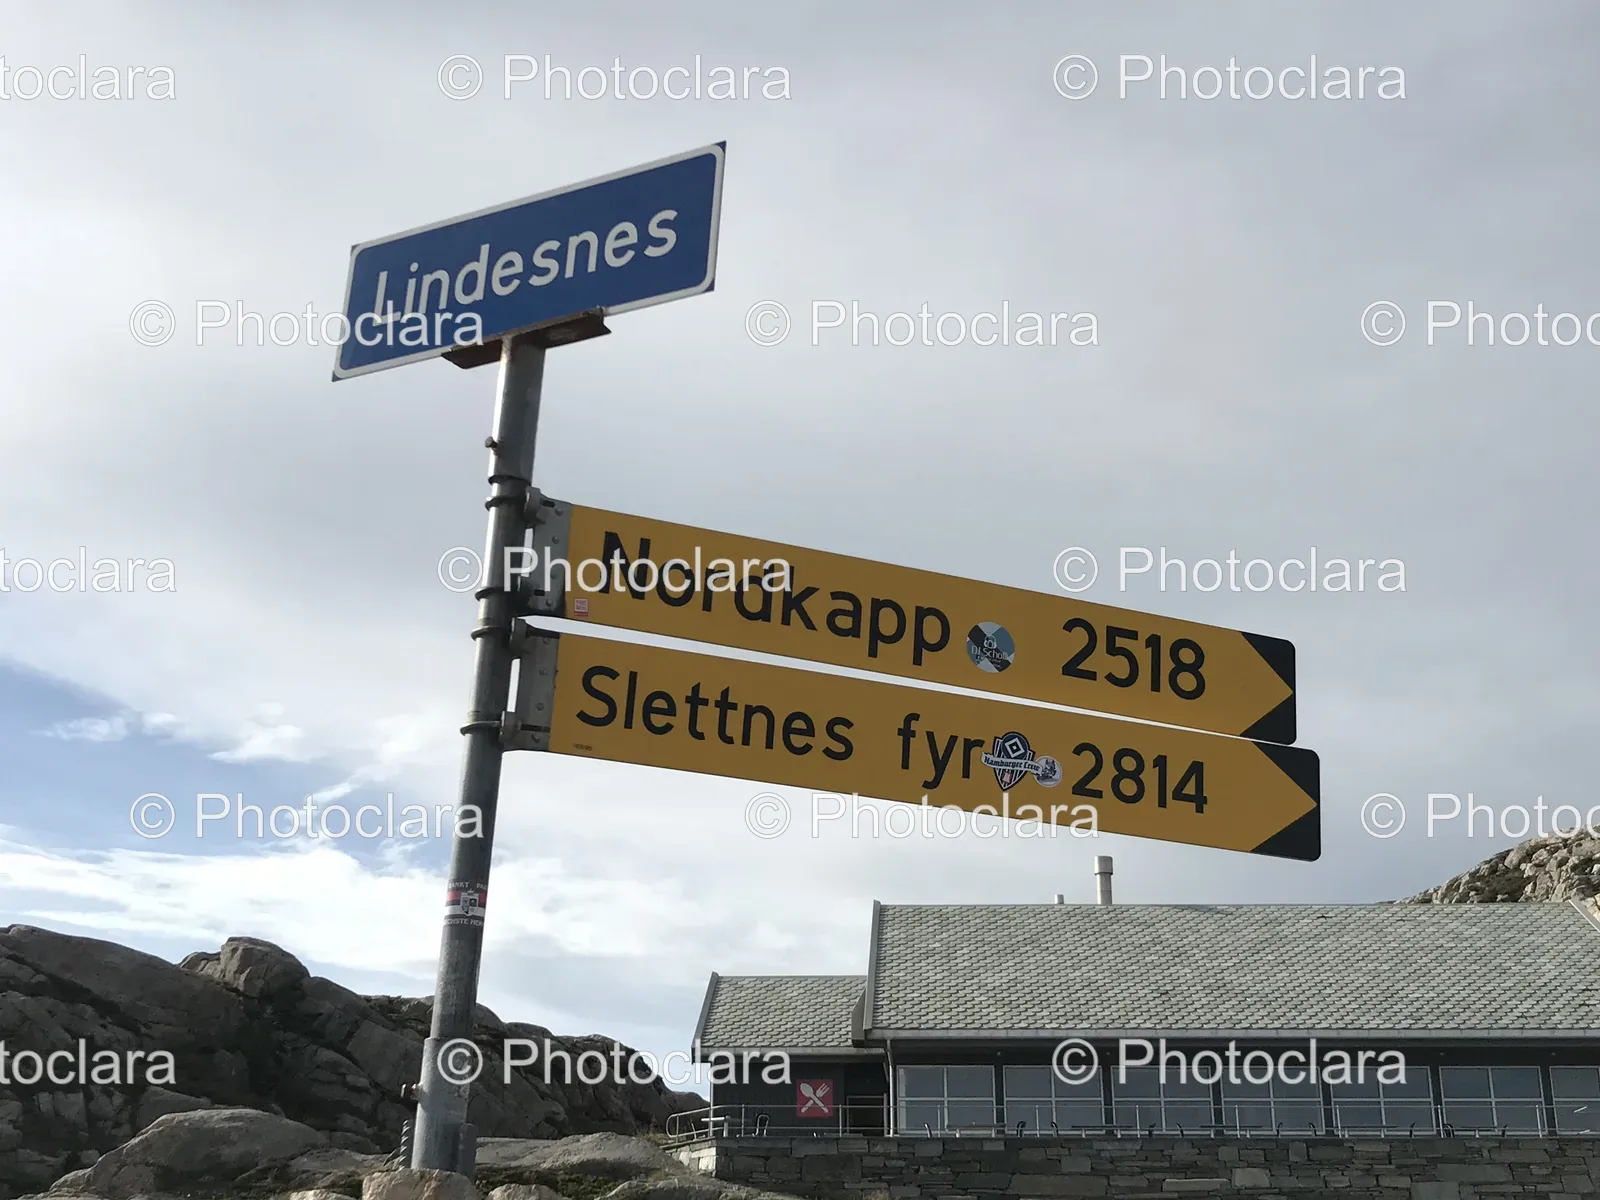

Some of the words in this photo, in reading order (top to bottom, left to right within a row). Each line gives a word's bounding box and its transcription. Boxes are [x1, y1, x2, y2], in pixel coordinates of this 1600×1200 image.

[373, 209, 678, 326] Lindesnes
[601, 531, 950, 666] Nordkapp
[1061, 617, 1206, 700] 2518
[575, 665, 854, 761] Slettnes
[897, 712, 984, 790] fyr
[1071, 742, 1208, 814] 2814
[984, 756, 1023, 769] Hamburger
